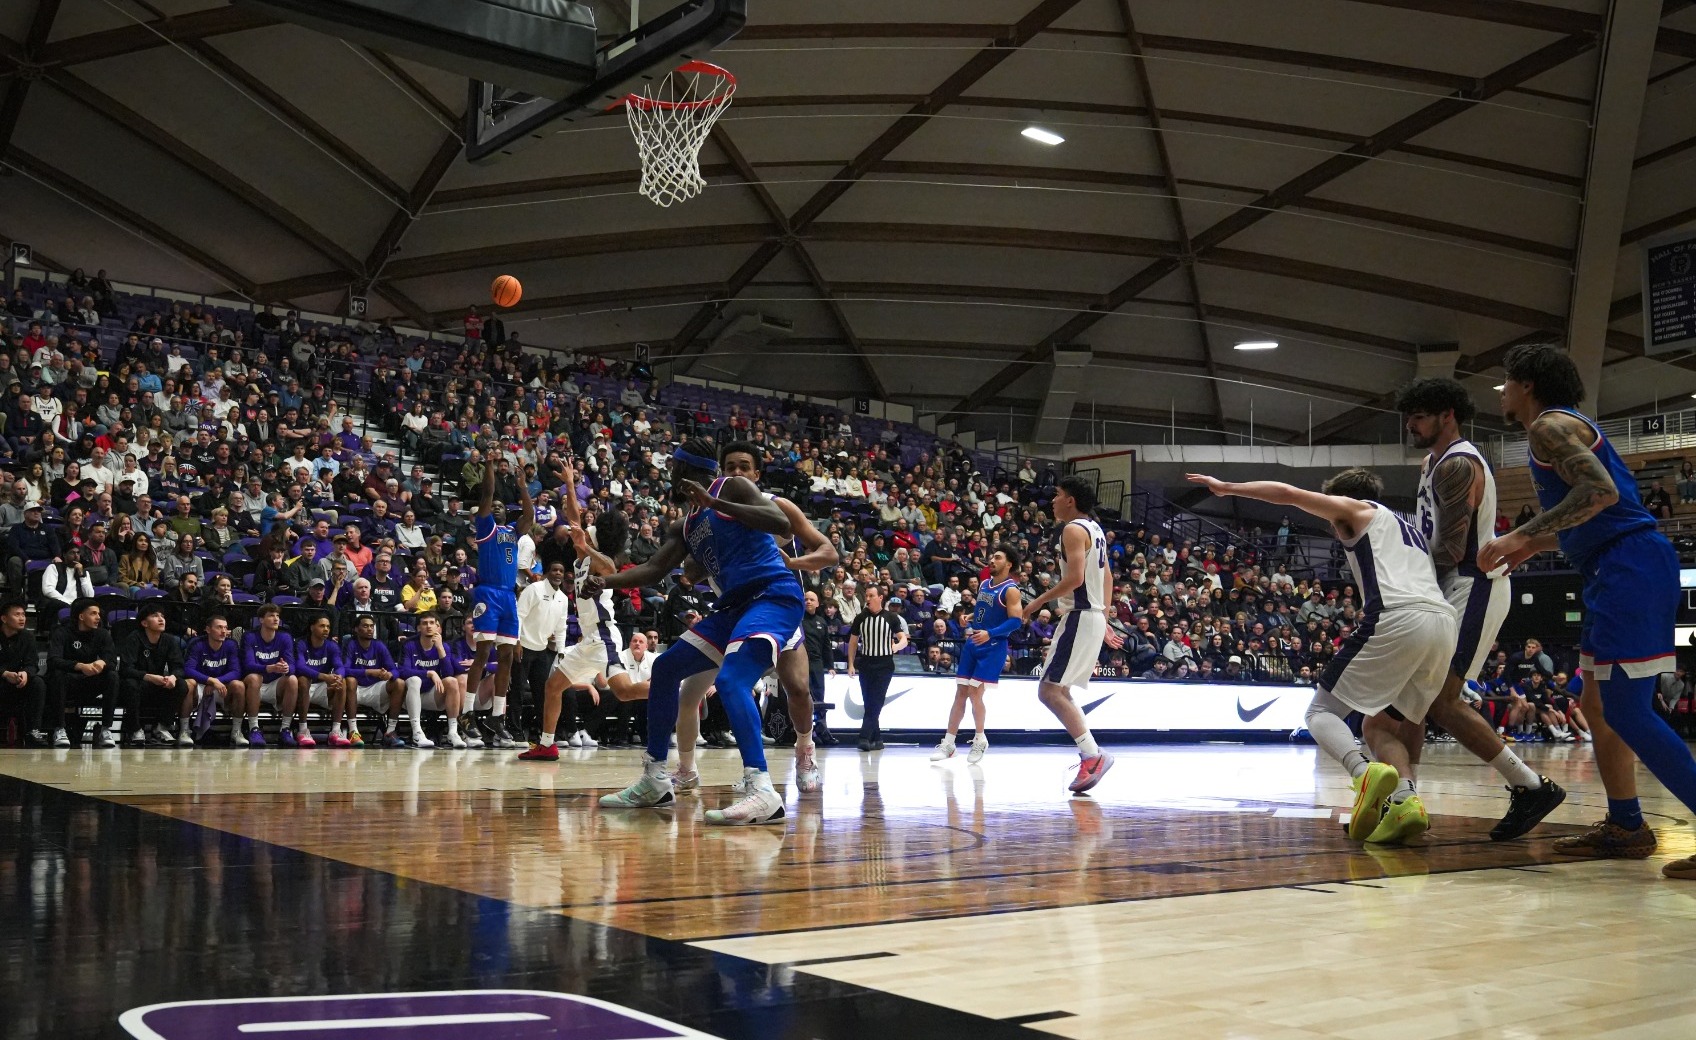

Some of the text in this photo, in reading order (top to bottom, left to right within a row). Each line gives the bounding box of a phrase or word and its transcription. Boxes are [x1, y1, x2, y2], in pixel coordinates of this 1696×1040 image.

[14, 247, 28, 261] 12
[354, 301, 366, 313] 13
[637, 347, 646, 358] 14
[858, 400, 867, 411] 15
[1647, 419, 1659, 430] 16
[1393, 513, 1429, 555] 10
[505, 547, 514, 564] 5
[976, 607, 986, 623] 3
